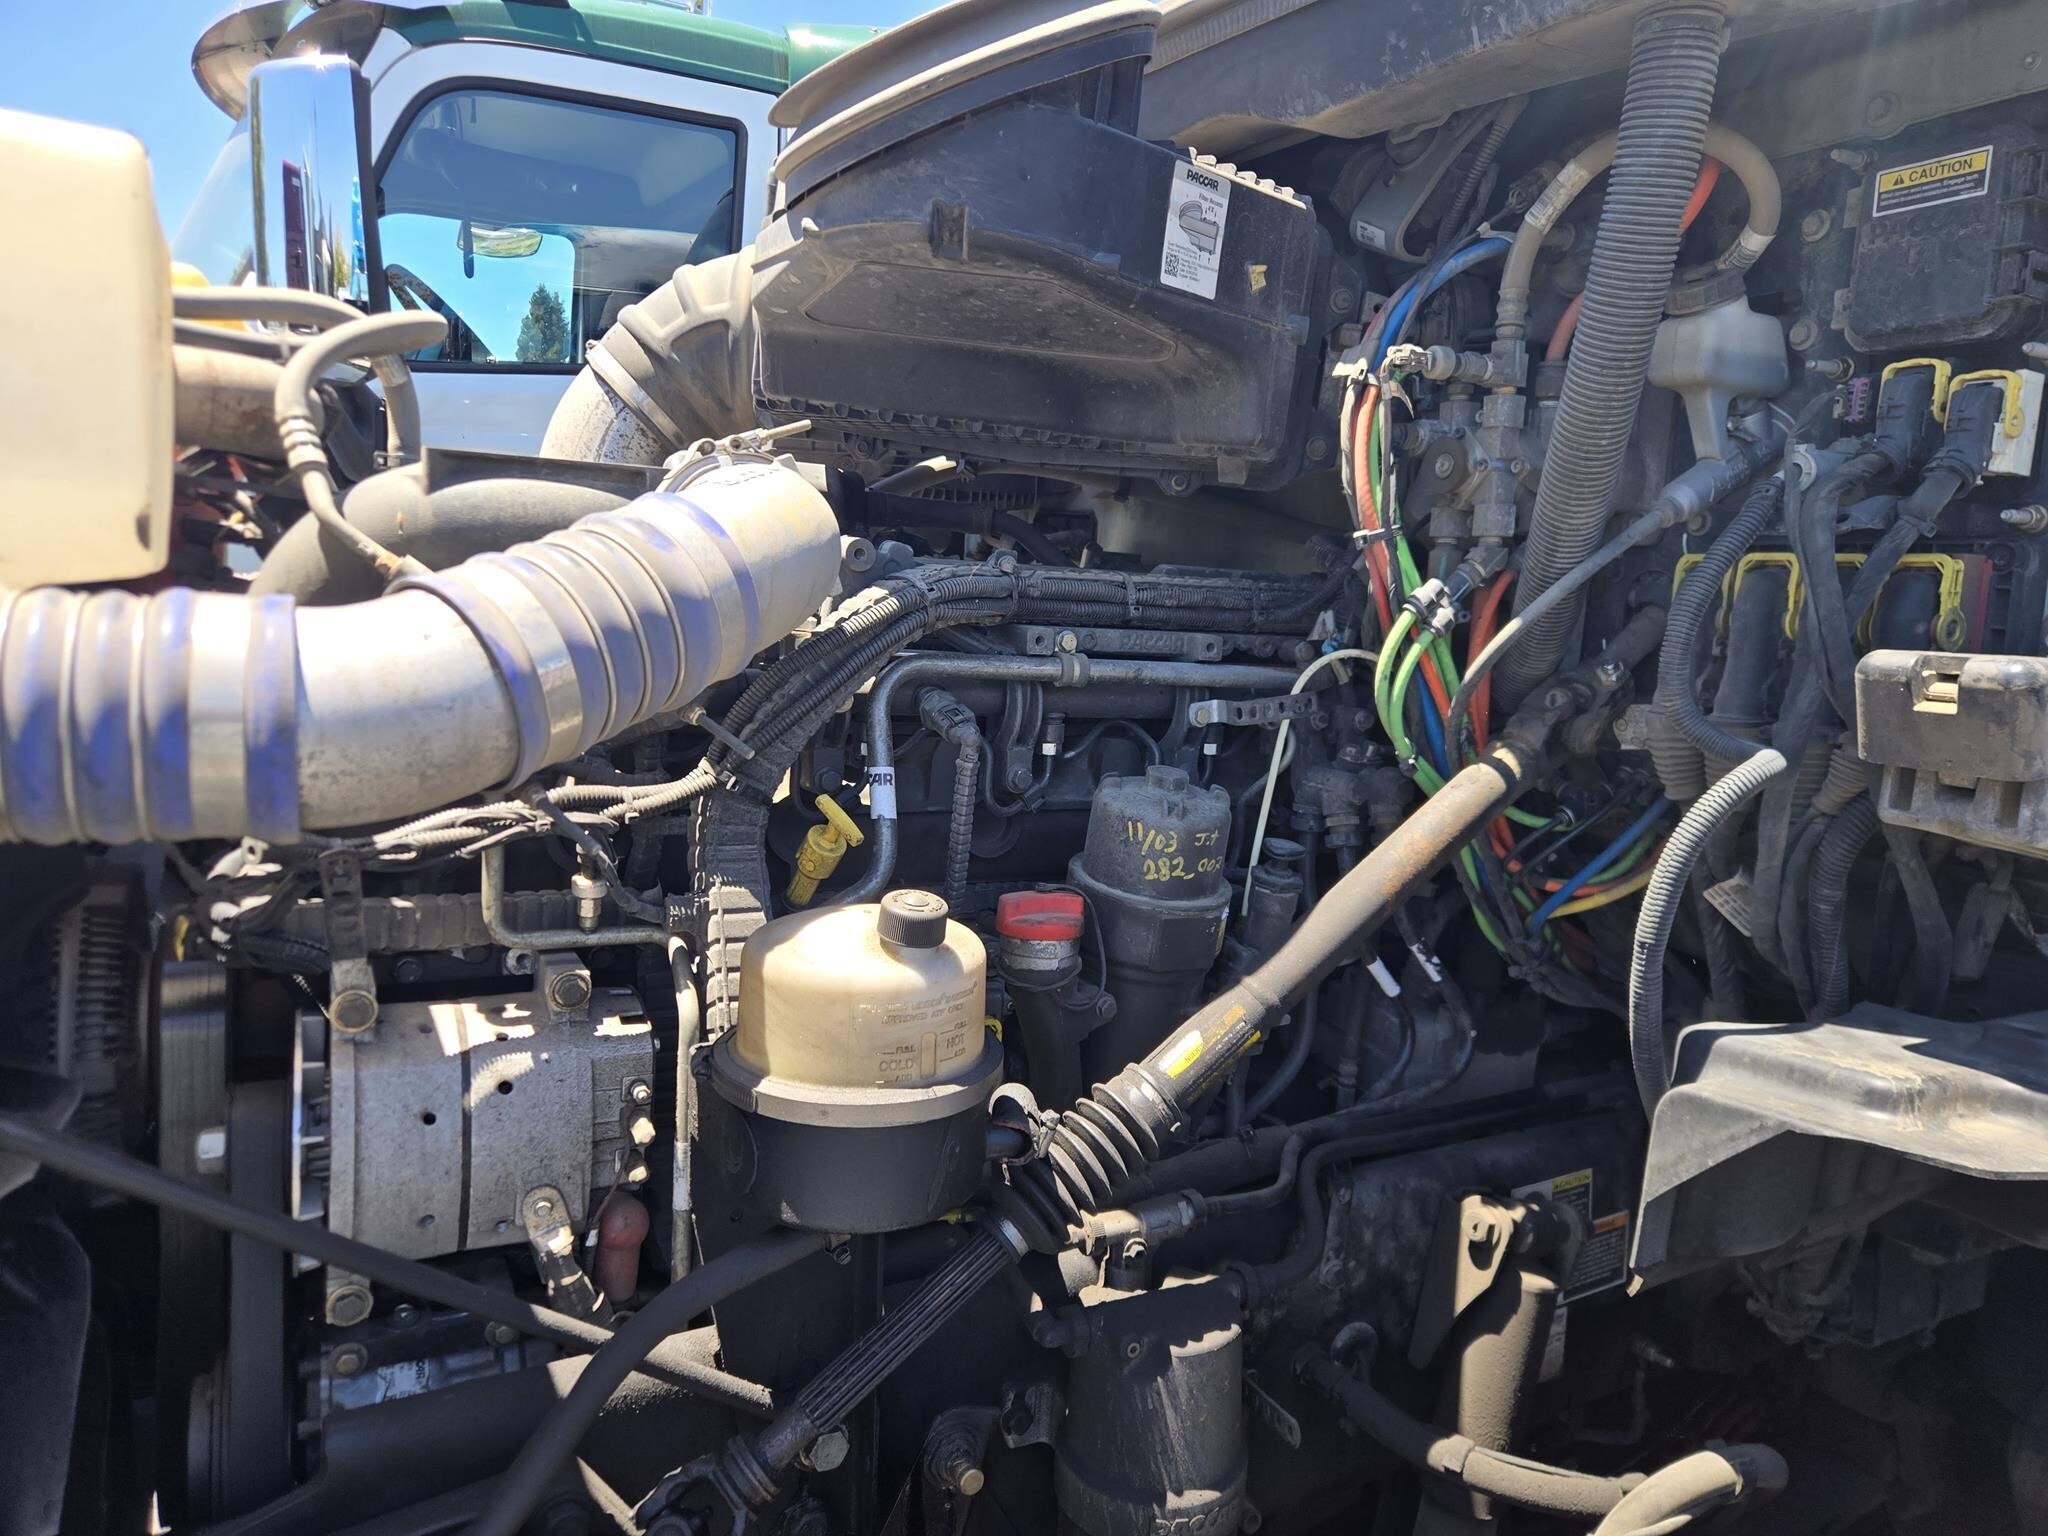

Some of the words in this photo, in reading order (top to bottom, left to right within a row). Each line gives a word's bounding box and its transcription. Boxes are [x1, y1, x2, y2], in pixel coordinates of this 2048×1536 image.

[1187, 169, 1219, 192] PACCAR
[1908, 158, 1973, 183] CAUTION
[1127, 820, 1178, 856] 11/03
[946, 1032, 966, 1050] HOT
[879, 1058, 914, 1073] COLD
